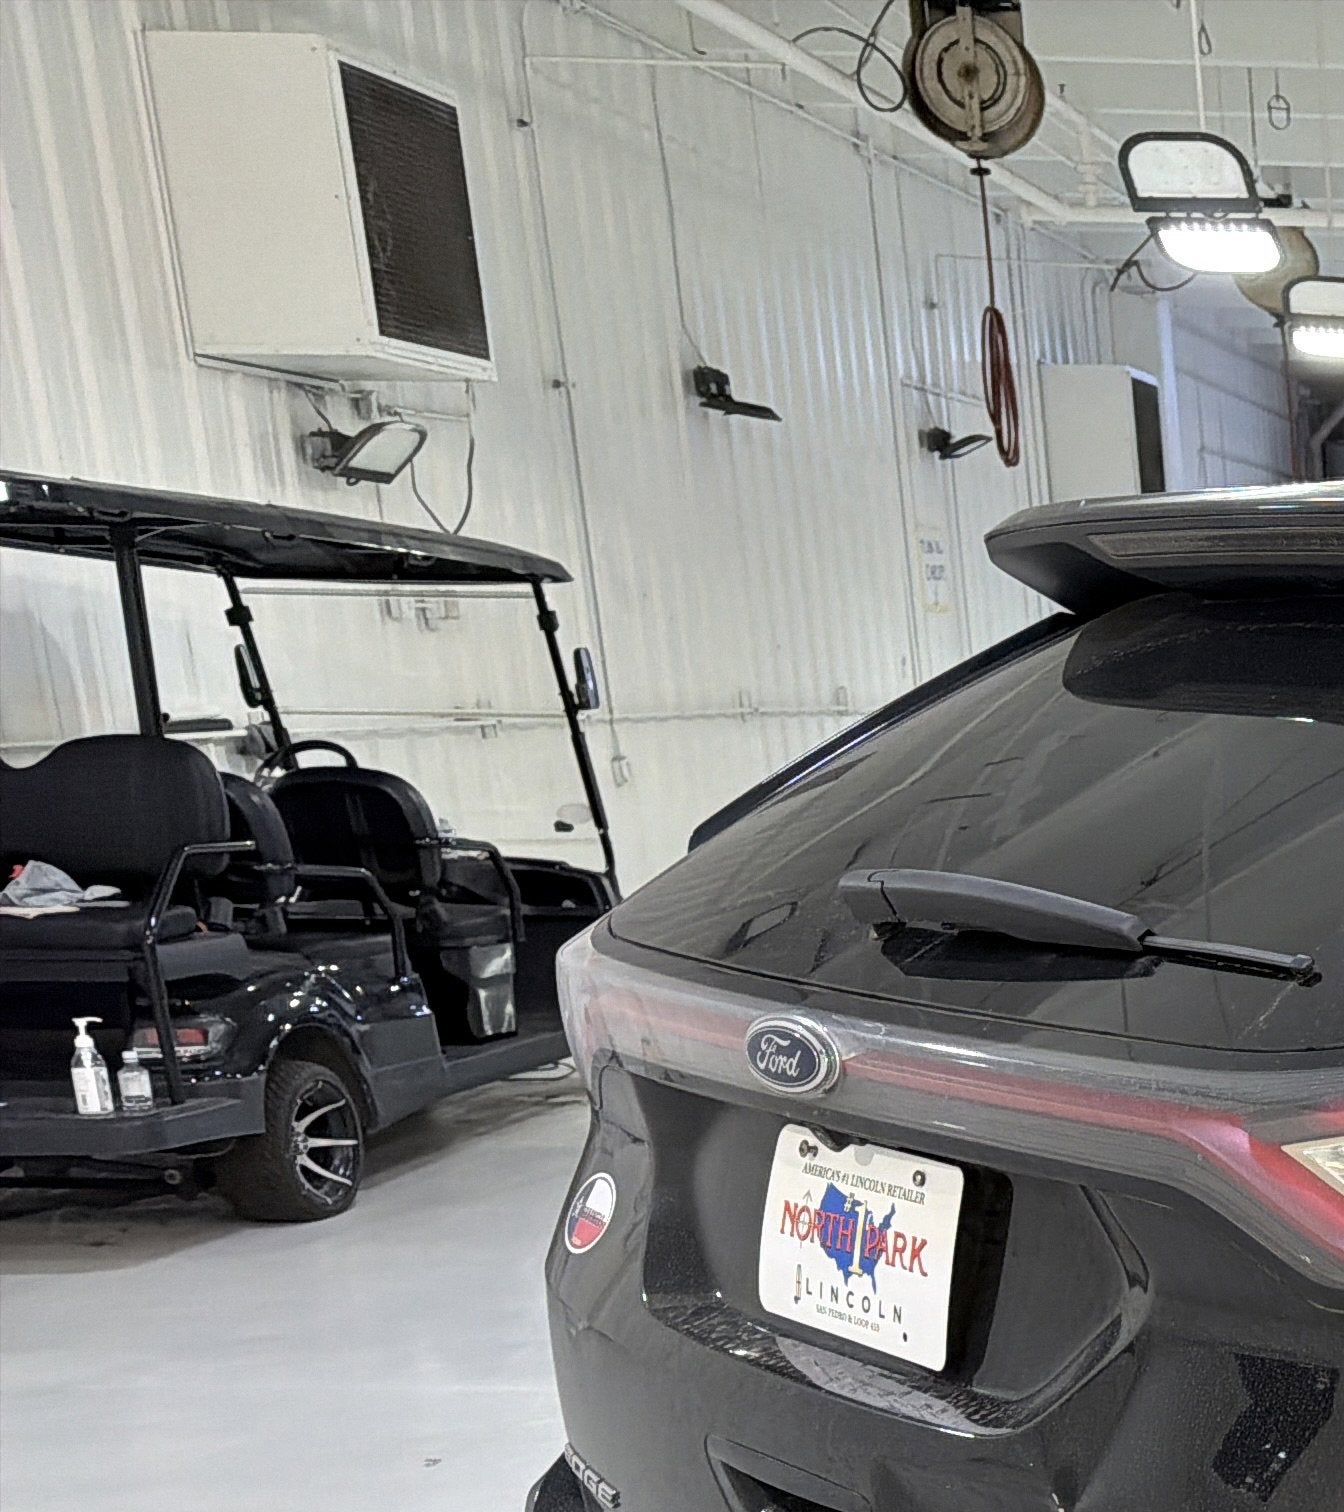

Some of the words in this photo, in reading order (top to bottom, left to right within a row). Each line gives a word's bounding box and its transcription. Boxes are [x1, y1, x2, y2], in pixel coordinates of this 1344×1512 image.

[756, 1034, 801, 1077] Ford
[801, 1162, 841, 1182] AMERICA'S
[841, 1171, 850, 1185] #1
[850, 1174, 887, 1195] LINCOLN
[886, 1183, 926, 1205] RETAILER
[780, 1199, 855, 1254] NORTH
[863, 1221, 929, 1277] PARK
[805, 1277, 903, 1325] LINCOLN
